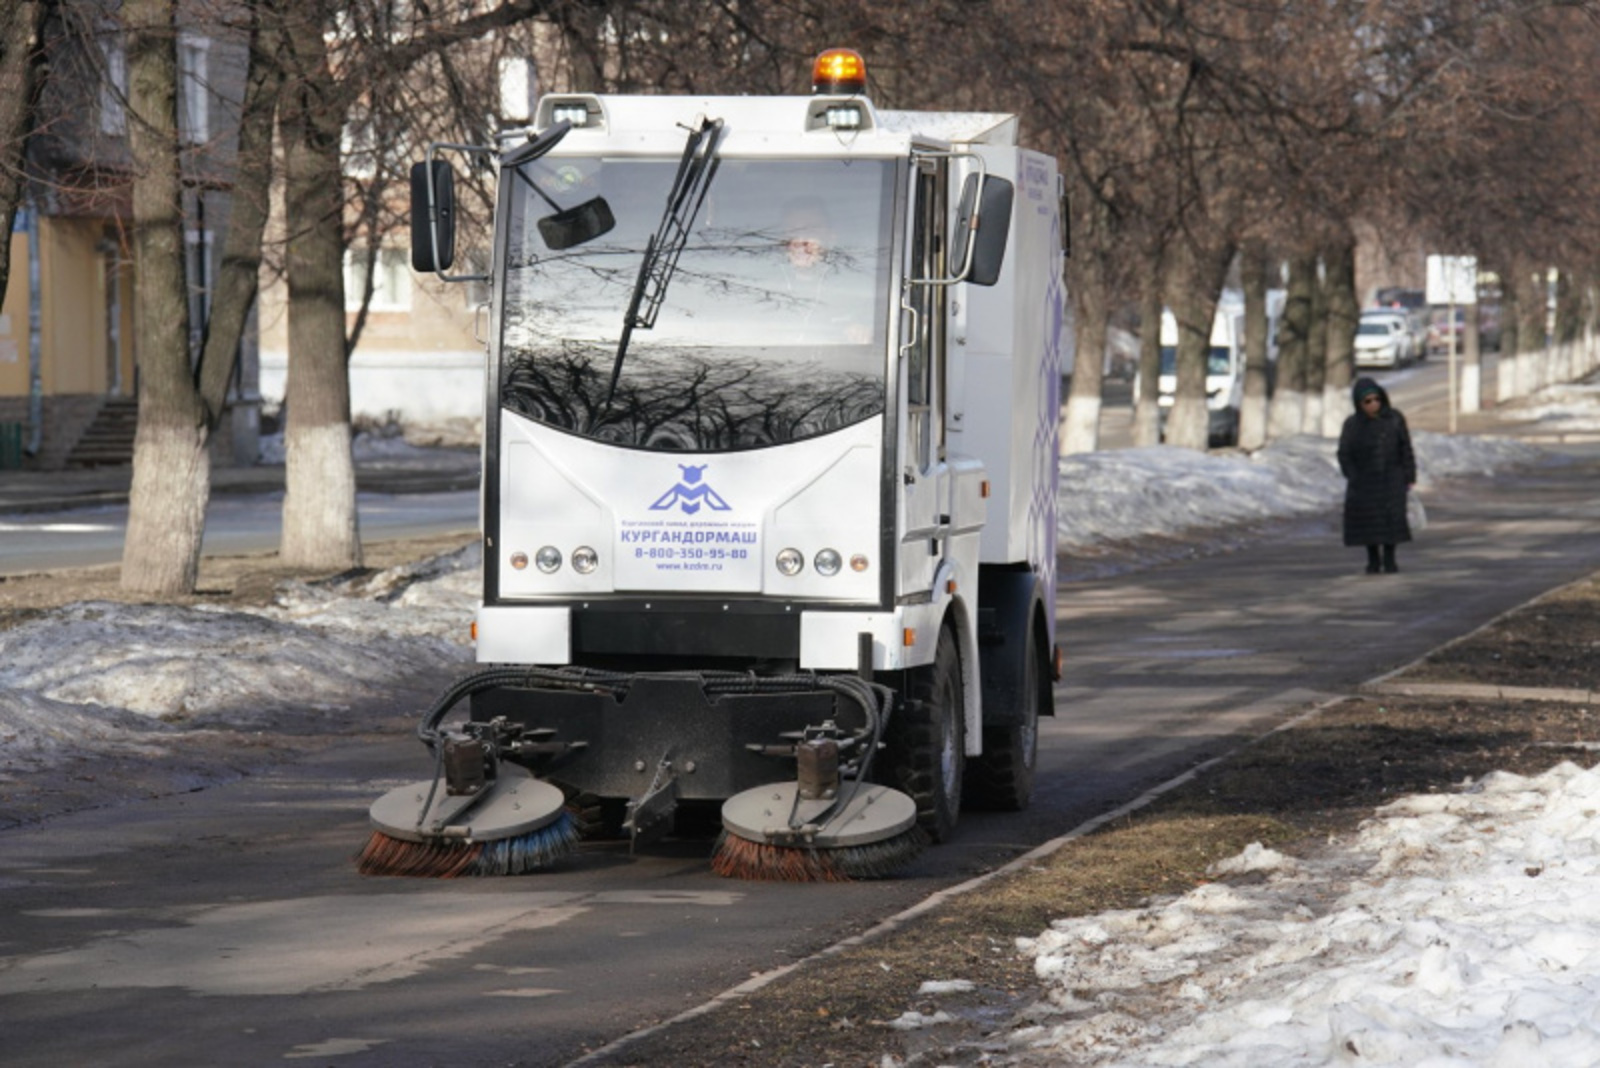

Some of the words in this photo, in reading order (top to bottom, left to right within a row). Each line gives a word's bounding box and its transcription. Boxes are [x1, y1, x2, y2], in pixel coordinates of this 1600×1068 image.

[621, 530, 757, 544] КУРГАНДОРМАШ
[635, 547, 748, 559] 8-800-350-95-80
[656, 562, 723, 571] www.kzdm.ru
